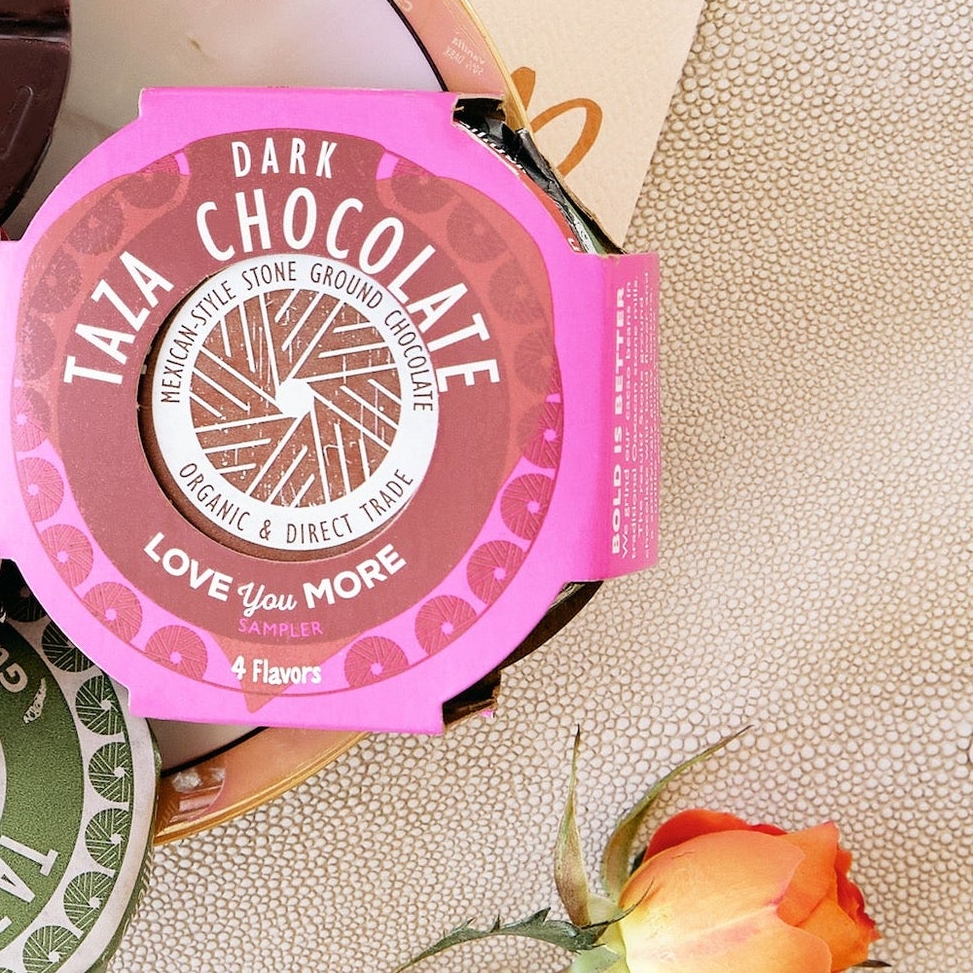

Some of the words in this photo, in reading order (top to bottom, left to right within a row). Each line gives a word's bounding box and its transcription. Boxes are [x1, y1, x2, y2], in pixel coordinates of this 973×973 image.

[231, 137, 337, 179] DARK
[64, 251, 174, 385] TAZA
[196, 187, 500, 393] CHOCOLATE
[161, 280, 236, 403] MEXICAN-STYLE
[242, 261, 297, 291] STONE
[310, 263, 383, 310] GROUND
[384, 309, 434, 412] CHOCOLATE
[615, 287, 624, 415] BETTER
[613, 426, 623, 454] IS
[179, 462, 251, 532] ORGANIC
[259, 519, 271, 542] &
[286, 513, 353, 544] DIRECT
[359, 468, 414, 523] TRADE
[612, 464, 621, 554] BOLD
[143, 532, 233, 602] LOVE
[237, 581, 298, 618] You
[302, 543, 407, 609] MORE
[237, 617, 323, 638] SAMPLER
[230, 655, 246, 680] 4
[252, 658, 322, 685] Flavors
